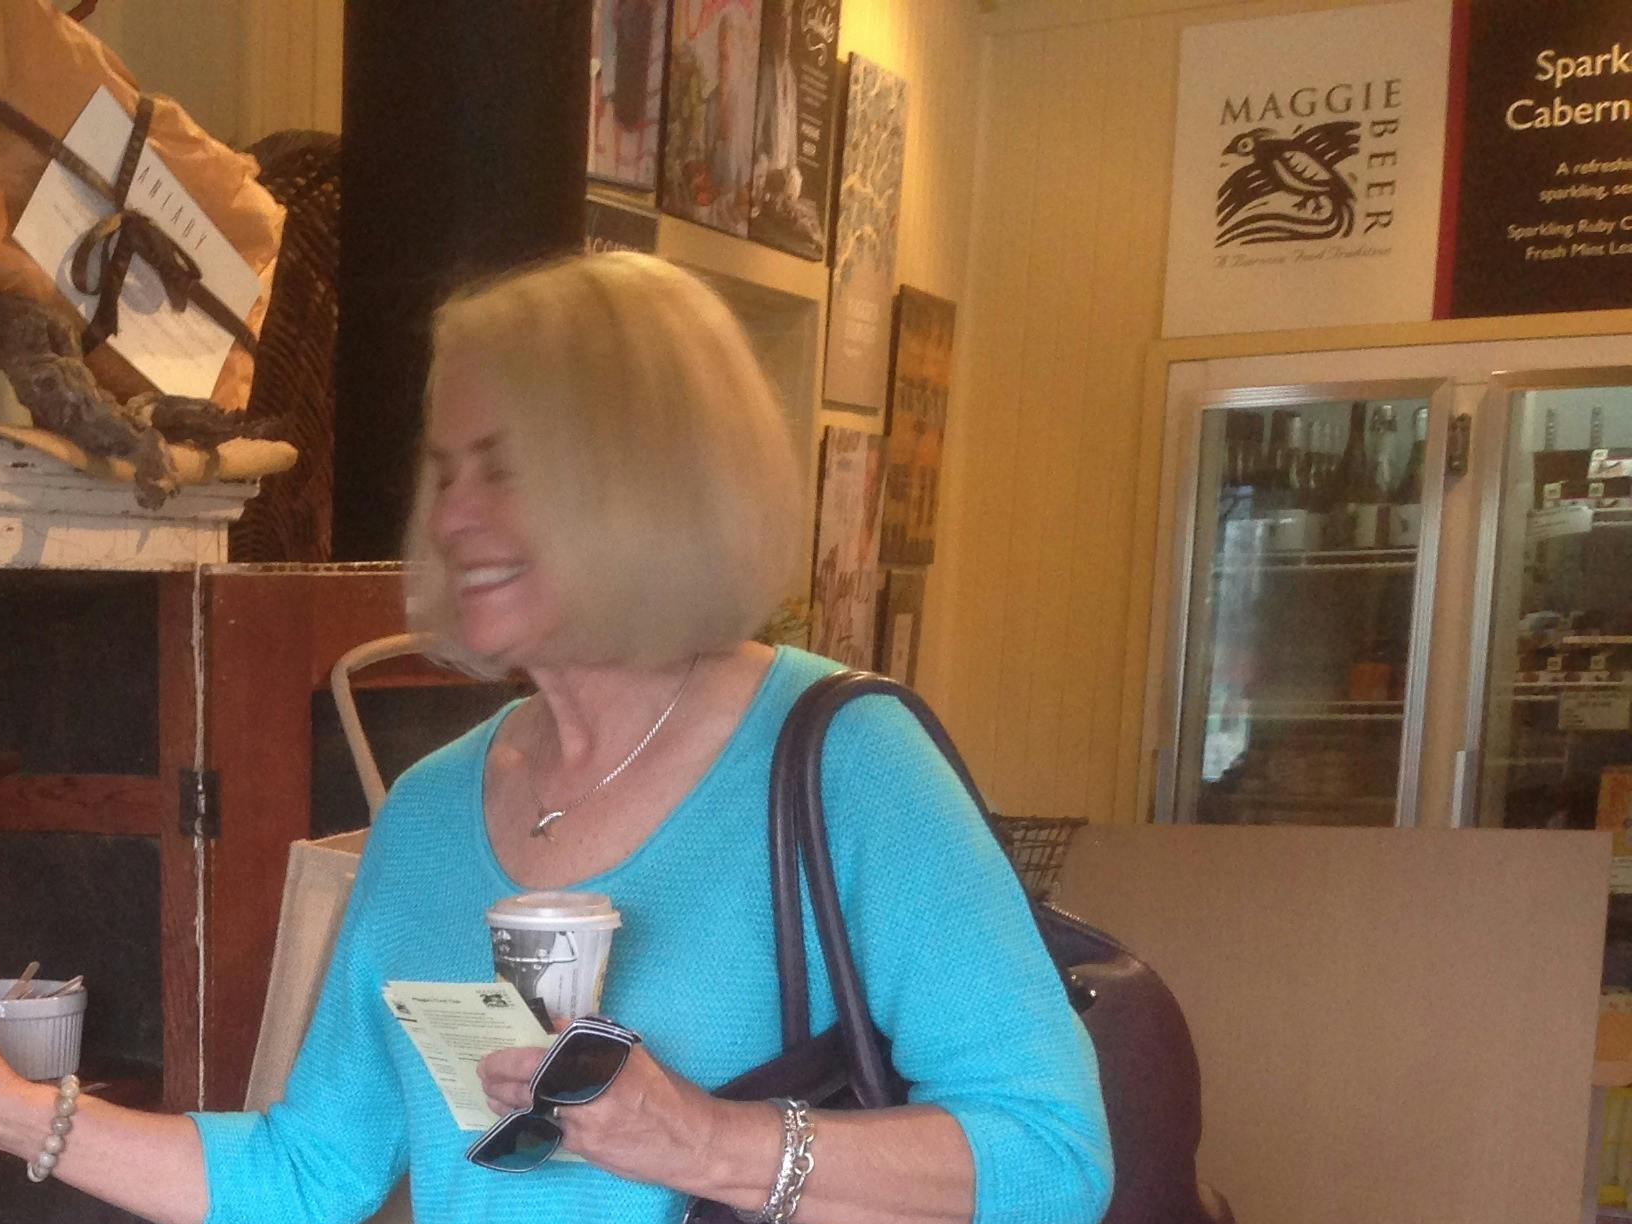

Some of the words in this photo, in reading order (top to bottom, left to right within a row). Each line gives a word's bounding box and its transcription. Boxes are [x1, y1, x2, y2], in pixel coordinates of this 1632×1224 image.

[1220, 78, 1402, 126] MAGGIE
[1364, 118, 1399, 234] BEER
[1555, 162, 1569, 176] A
[1577, 217, 1617, 235] Ruby
